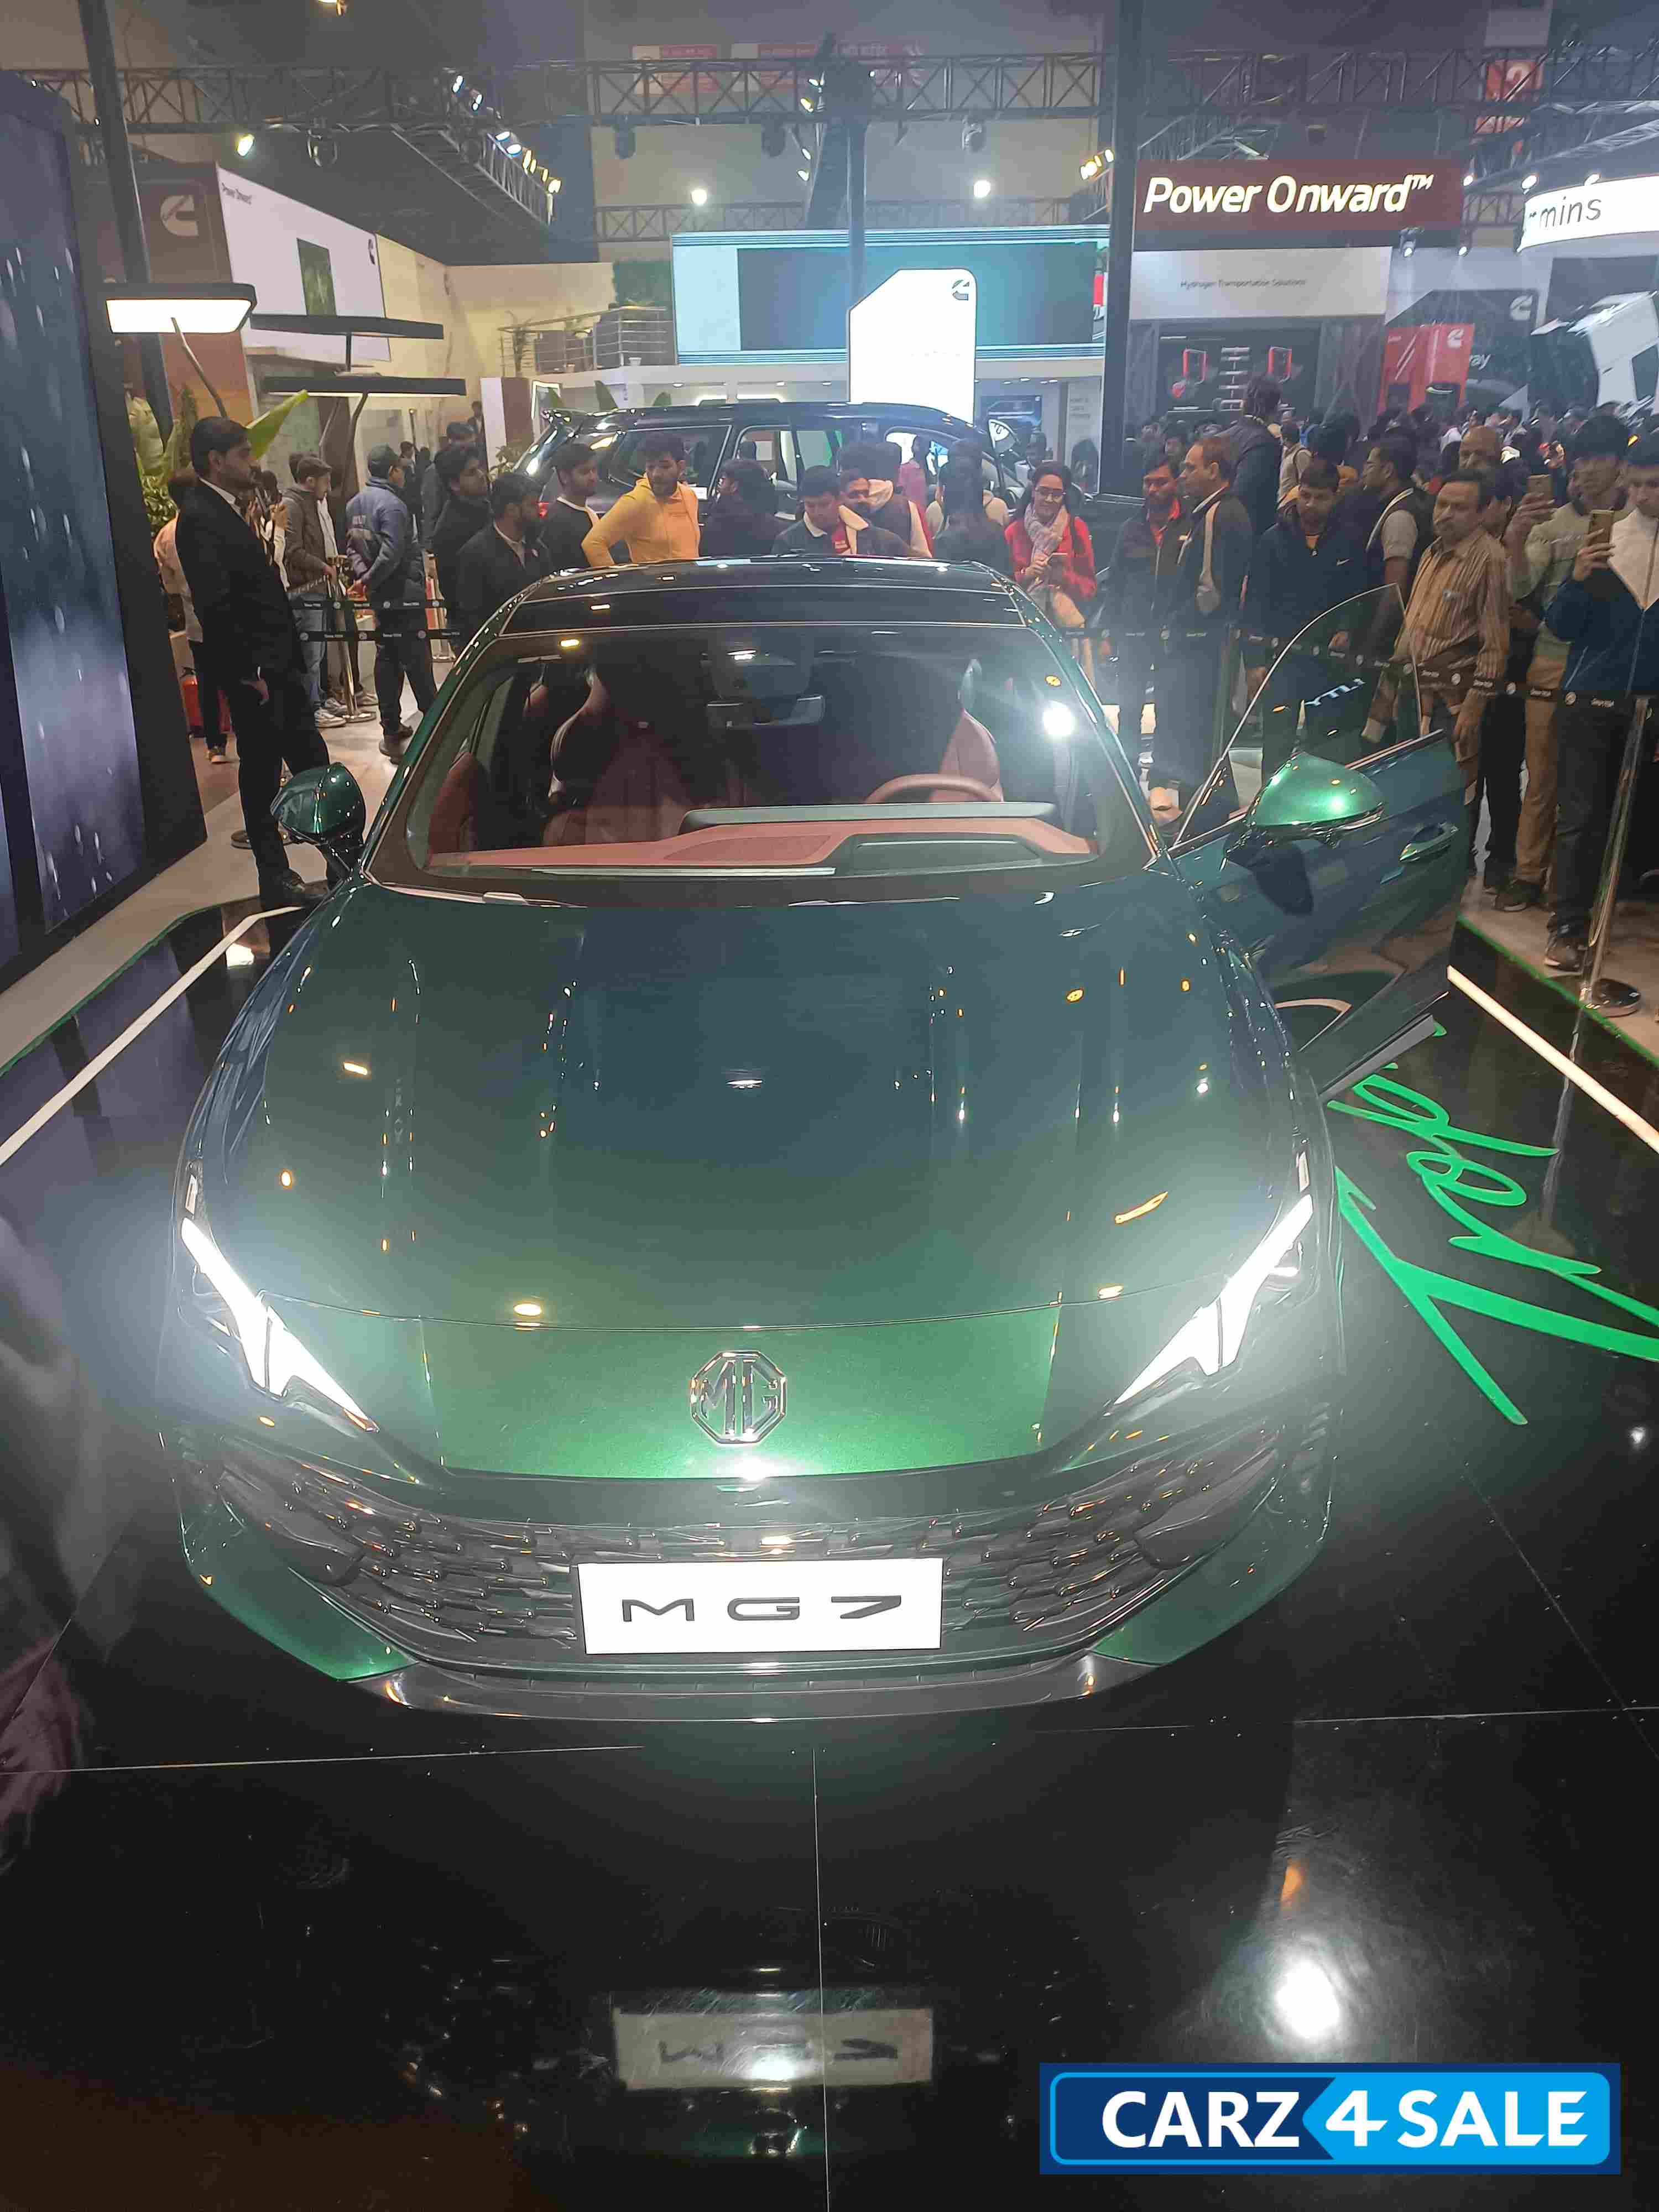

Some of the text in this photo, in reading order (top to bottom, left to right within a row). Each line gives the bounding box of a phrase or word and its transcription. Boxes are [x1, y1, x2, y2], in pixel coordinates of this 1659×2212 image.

[1143, 176, 1263, 213] Power
[1528, 195, 1603, 229] mins
[698, 1357, 780, 1440] MG
